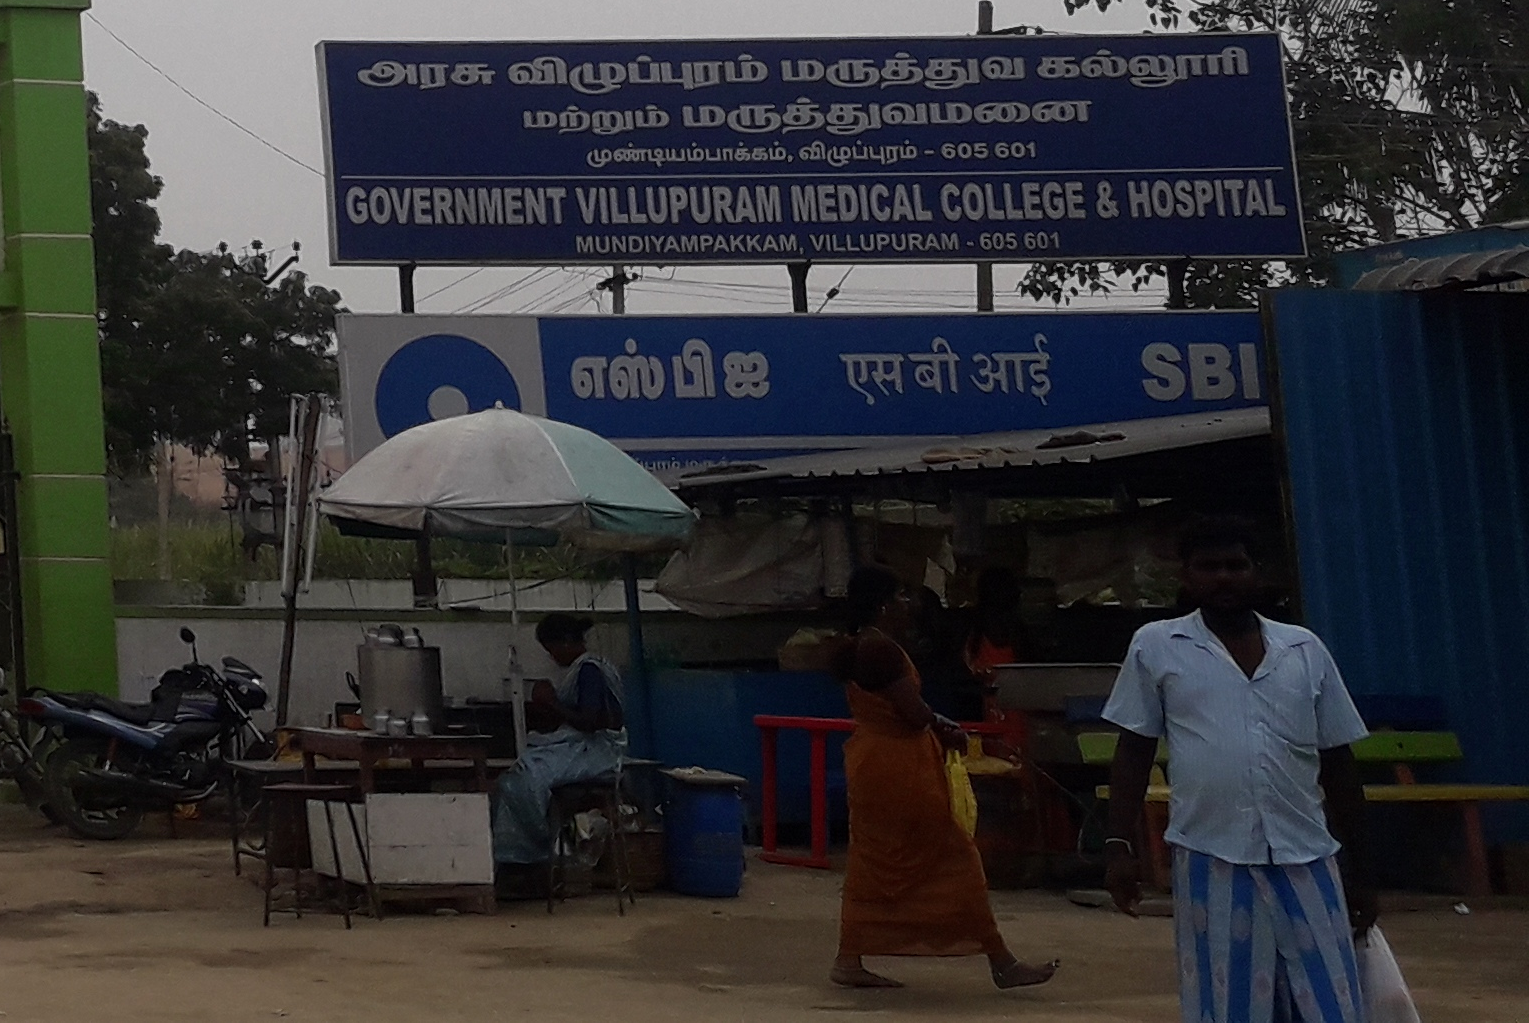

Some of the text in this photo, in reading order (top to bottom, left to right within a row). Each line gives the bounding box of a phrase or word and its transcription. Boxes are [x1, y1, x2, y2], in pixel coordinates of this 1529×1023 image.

[357, 46, 1249, 95] அரசு விழுப்புரம் மருத்துவ கல்லூரி
[523, 96, 1092, 136] மற்றும் மருத்துவமனை
[586, 140, 794, 169] முண்டியம்பாக்கம்,
[798, 139, 918, 168] விழுப்புரம்
[940, 142, 989, 160] 605
[994, 141, 1036, 159] 601
[346, 178, 1286, 225] GOVERNMENT VILLUPURAM MEDICAL COLLEGE & HOSPITAL
[575, 233, 804, 255] MUNDIYAMPAKKAM,
[809, 232, 960, 252] VILLUPURAM
[979, 232, 1018, 251] 605
[1023, 231, 1060, 250] 601
[1141, 342, 1261, 401] SBI
